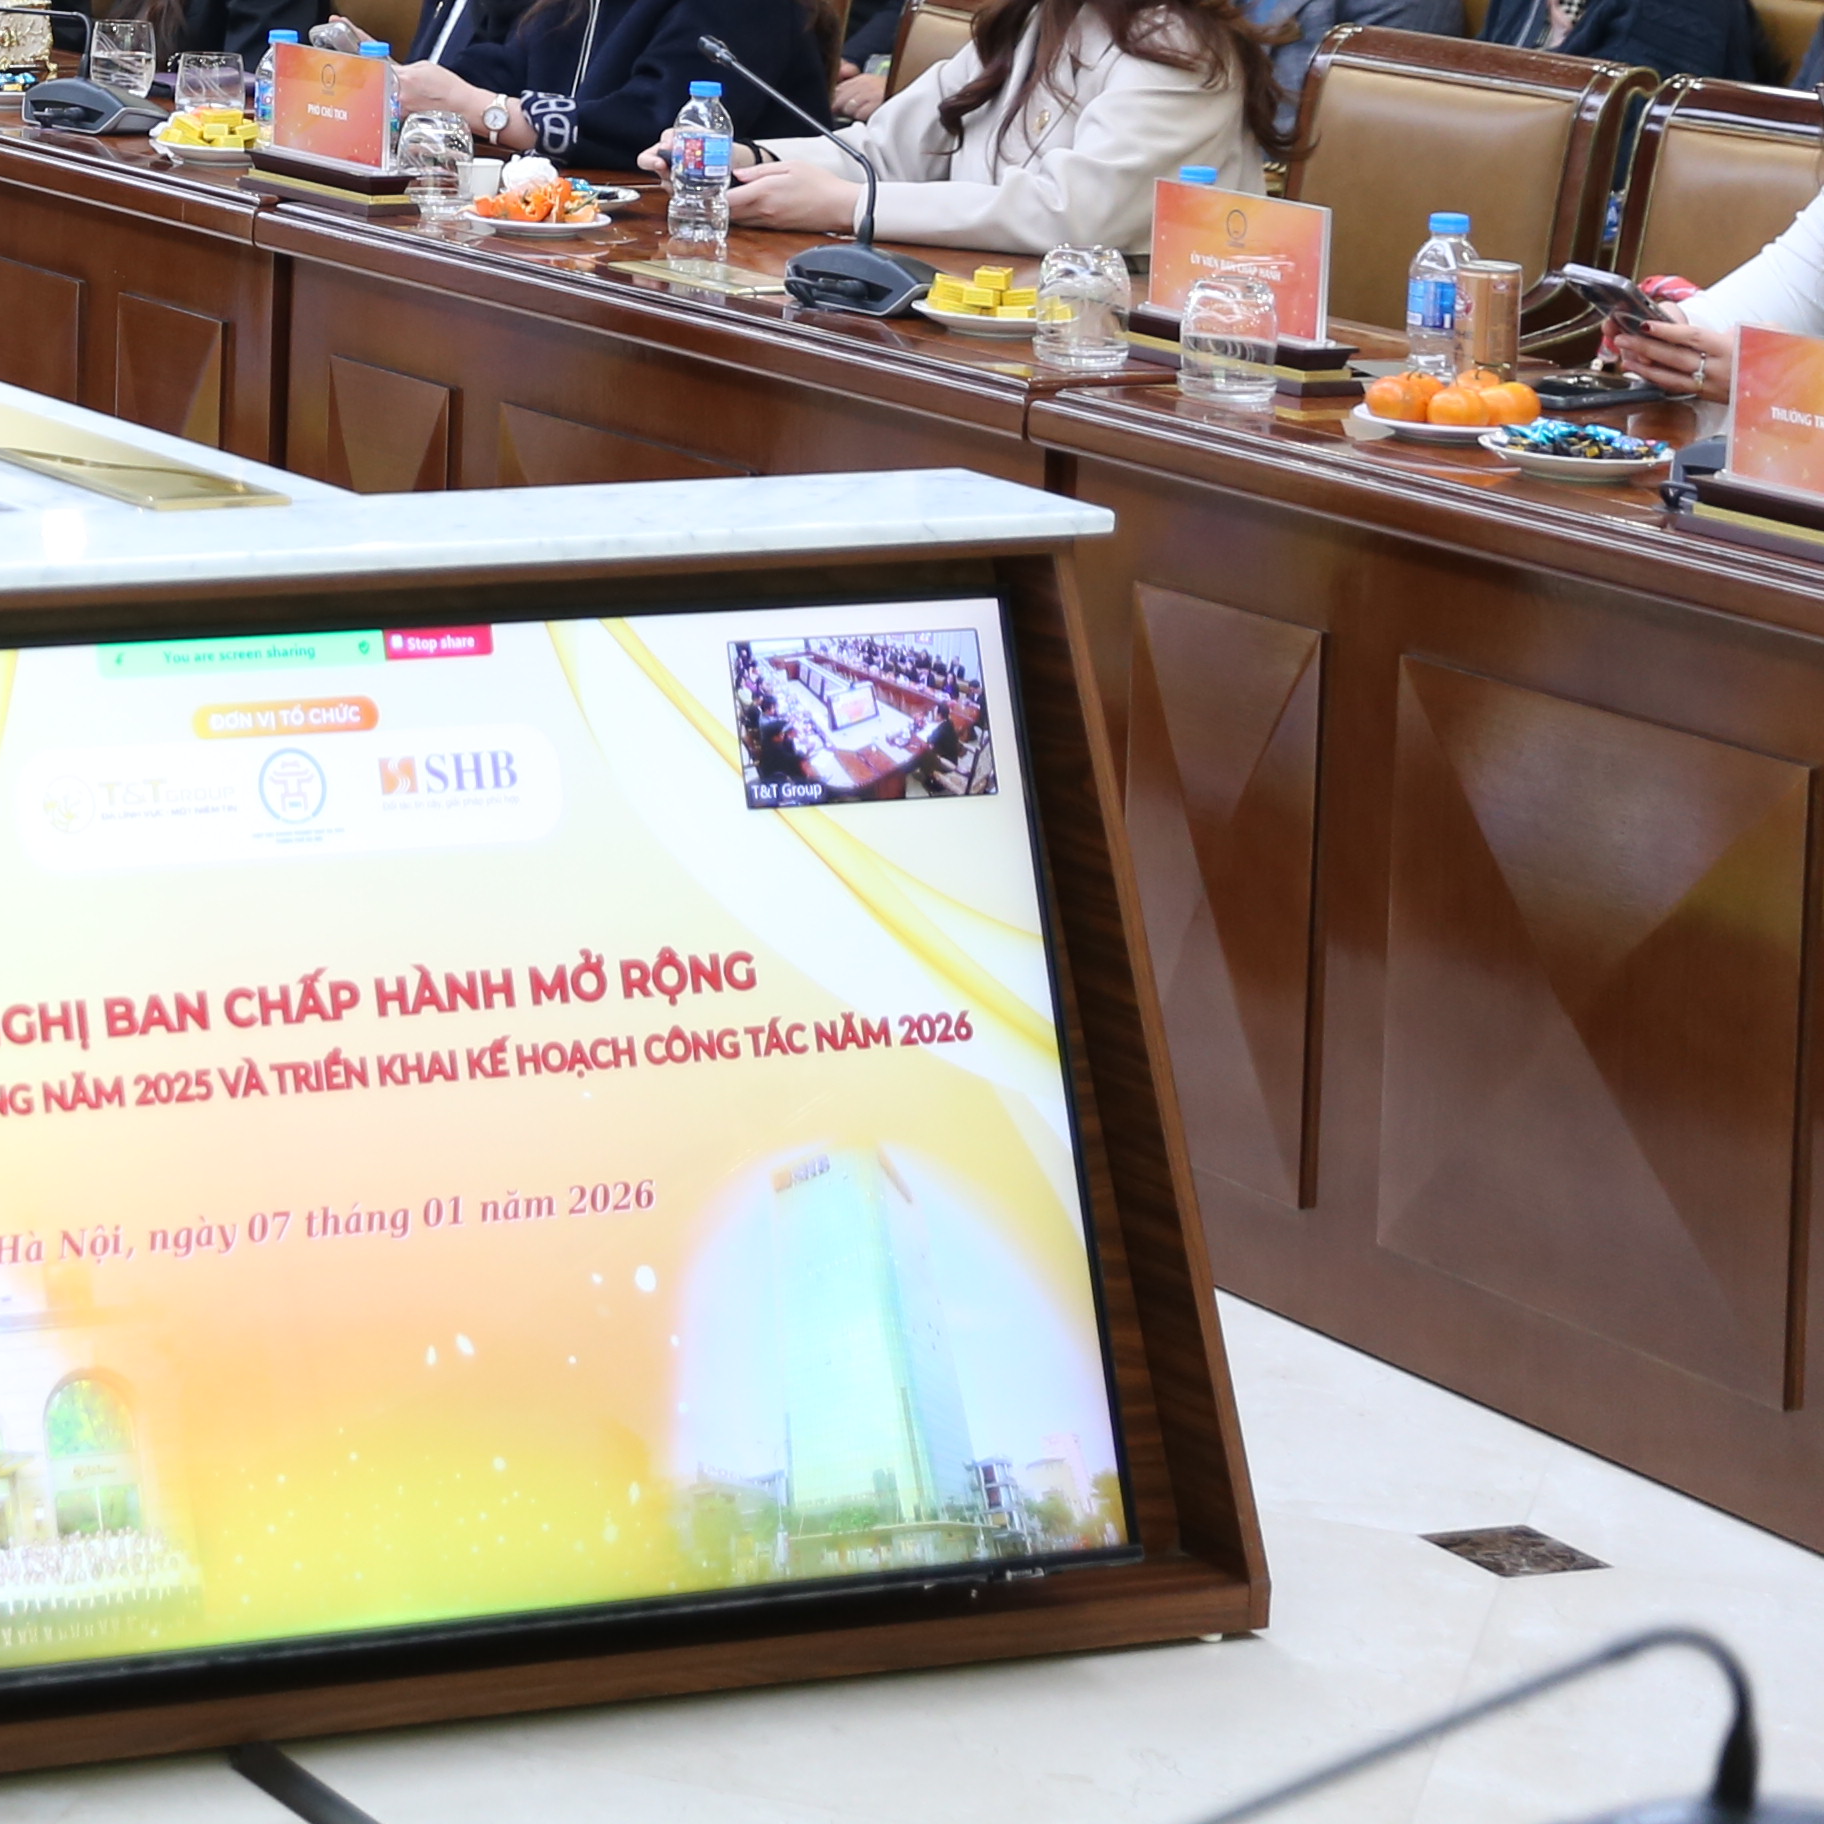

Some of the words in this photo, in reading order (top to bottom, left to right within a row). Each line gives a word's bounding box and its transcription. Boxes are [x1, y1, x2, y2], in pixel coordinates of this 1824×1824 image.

[163, 651, 185, 665] You
[187, 651, 214, 664] are
[219, 649, 262, 662] screen
[265, 644, 316, 662] sharing
[406, 635, 438, 654] Stop
[439, 633, 476, 650] share
[278, 703, 305, 728] TỔ
[307, 701, 362, 726] CHỨC
[425, 749, 519, 794] SHB
[752, 784, 779, 800] T&T
[782, 782, 823, 800] Group
[103, 991, 209, 1037] BAN
[223, 967, 360, 1029] CHẤP
[373, 964, 515, 1017] HÀNH
[528, 948, 607, 1006] MỞ
[619, 946, 757, 1006] RỘNG
[41, 1072, 125, 1113] NĂM
[133, 1068, 213, 1106] 2025
[217, 1057, 268, 1099] VÀ
[269, 1048, 369, 1094] TRIỂN
[376, 1049, 459, 1087] KHAI
[465, 1036, 509, 1080] KẾ
[515, 1035, 637, 1077] HOẠCH
[643, 1025, 741, 1065] CÔNG
[743, 1016, 808, 1057] TÁC
[813, 1012, 892, 1053] NĂM
[898, 1010, 973, 1046] 2026
[58, 1223, 134, 1263] Nội,
[148, 1215, 236, 1257] ngày
[246, 1210, 290, 1242] 07
[304, 1202, 409, 1238] tháng
[422, 1195, 462, 1227] 01
[479, 1189, 555, 1222] năm
[568, 1178, 654, 1215] 2026
